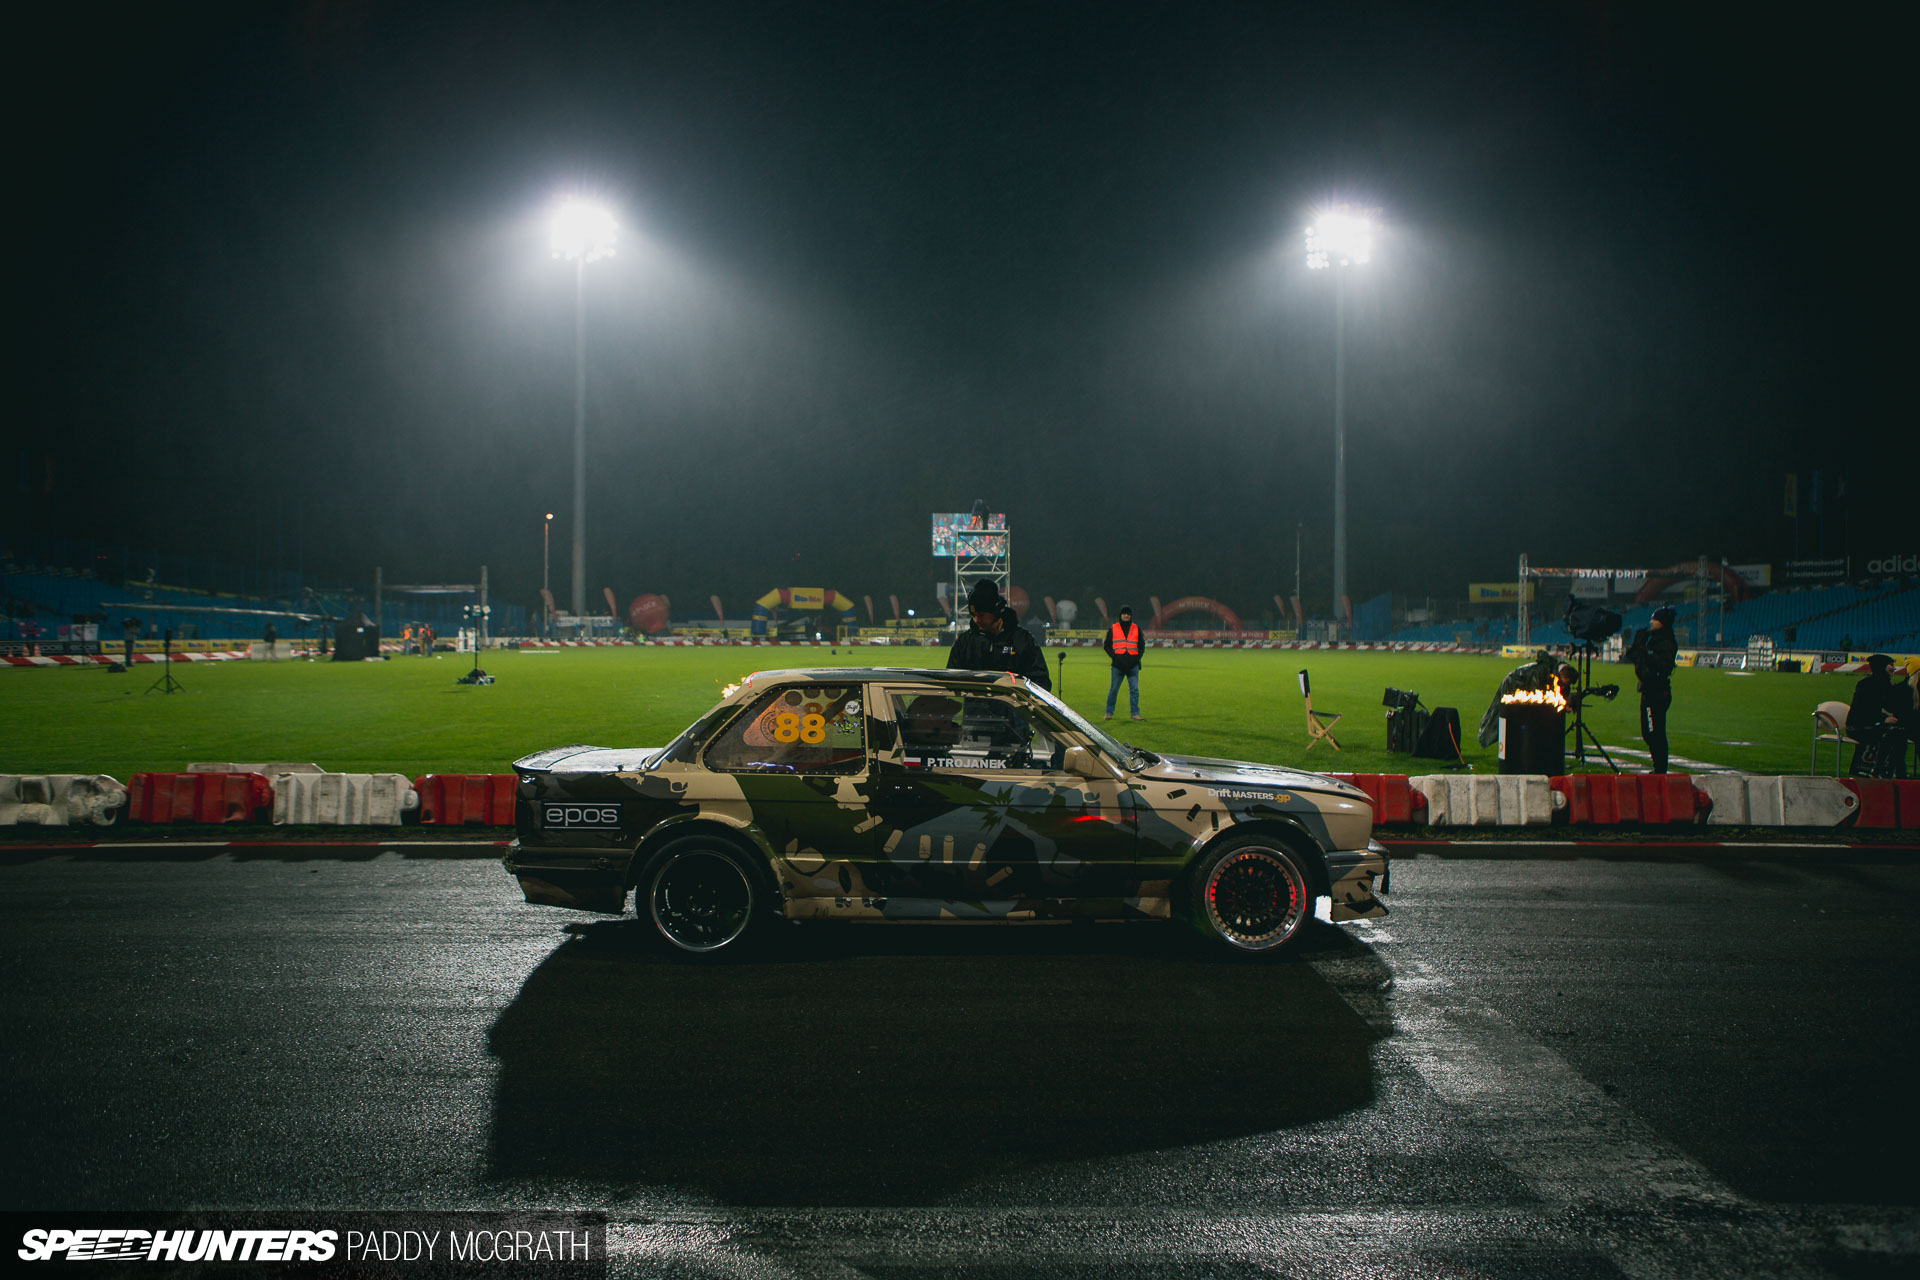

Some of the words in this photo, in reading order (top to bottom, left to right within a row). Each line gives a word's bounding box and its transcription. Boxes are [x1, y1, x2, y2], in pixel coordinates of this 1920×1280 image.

[1866, 554, 1920, 574] adid
[1578, 569, 1614, 579] START
[1616, 569, 1648, 579] DRIFT
[774, 712, 826, 744] 88
[927, 757, 1007, 769] P.TROJANEK
[1208, 788, 1231, 798] Drift
[546, 808, 618, 827] epos
